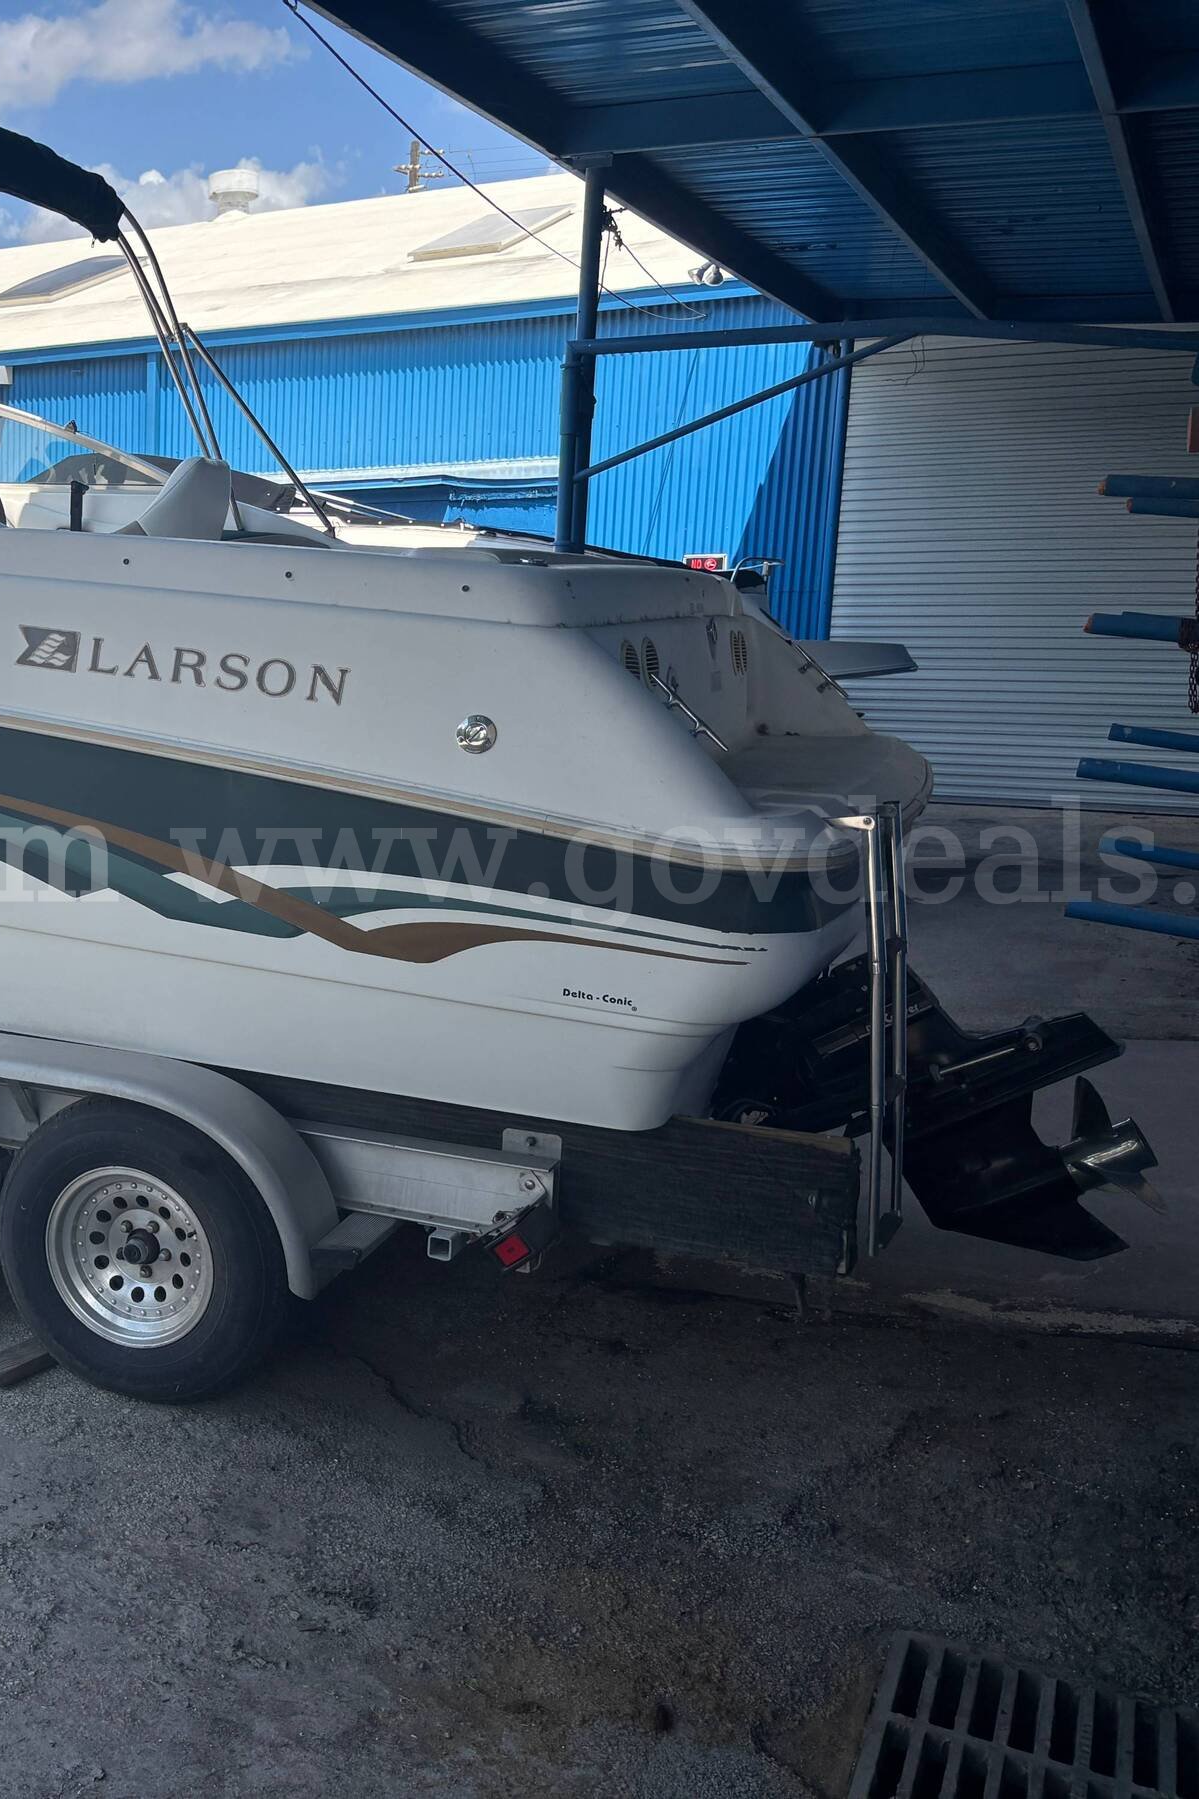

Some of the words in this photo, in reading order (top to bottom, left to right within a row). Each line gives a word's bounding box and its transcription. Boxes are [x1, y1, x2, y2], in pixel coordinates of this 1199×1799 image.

[691, 559, 702, 569] NO
[88, 637, 351, 706] LARSON
[562, 987, 594, 1001] Delta
[602, 994, 633, 1007] Conic
